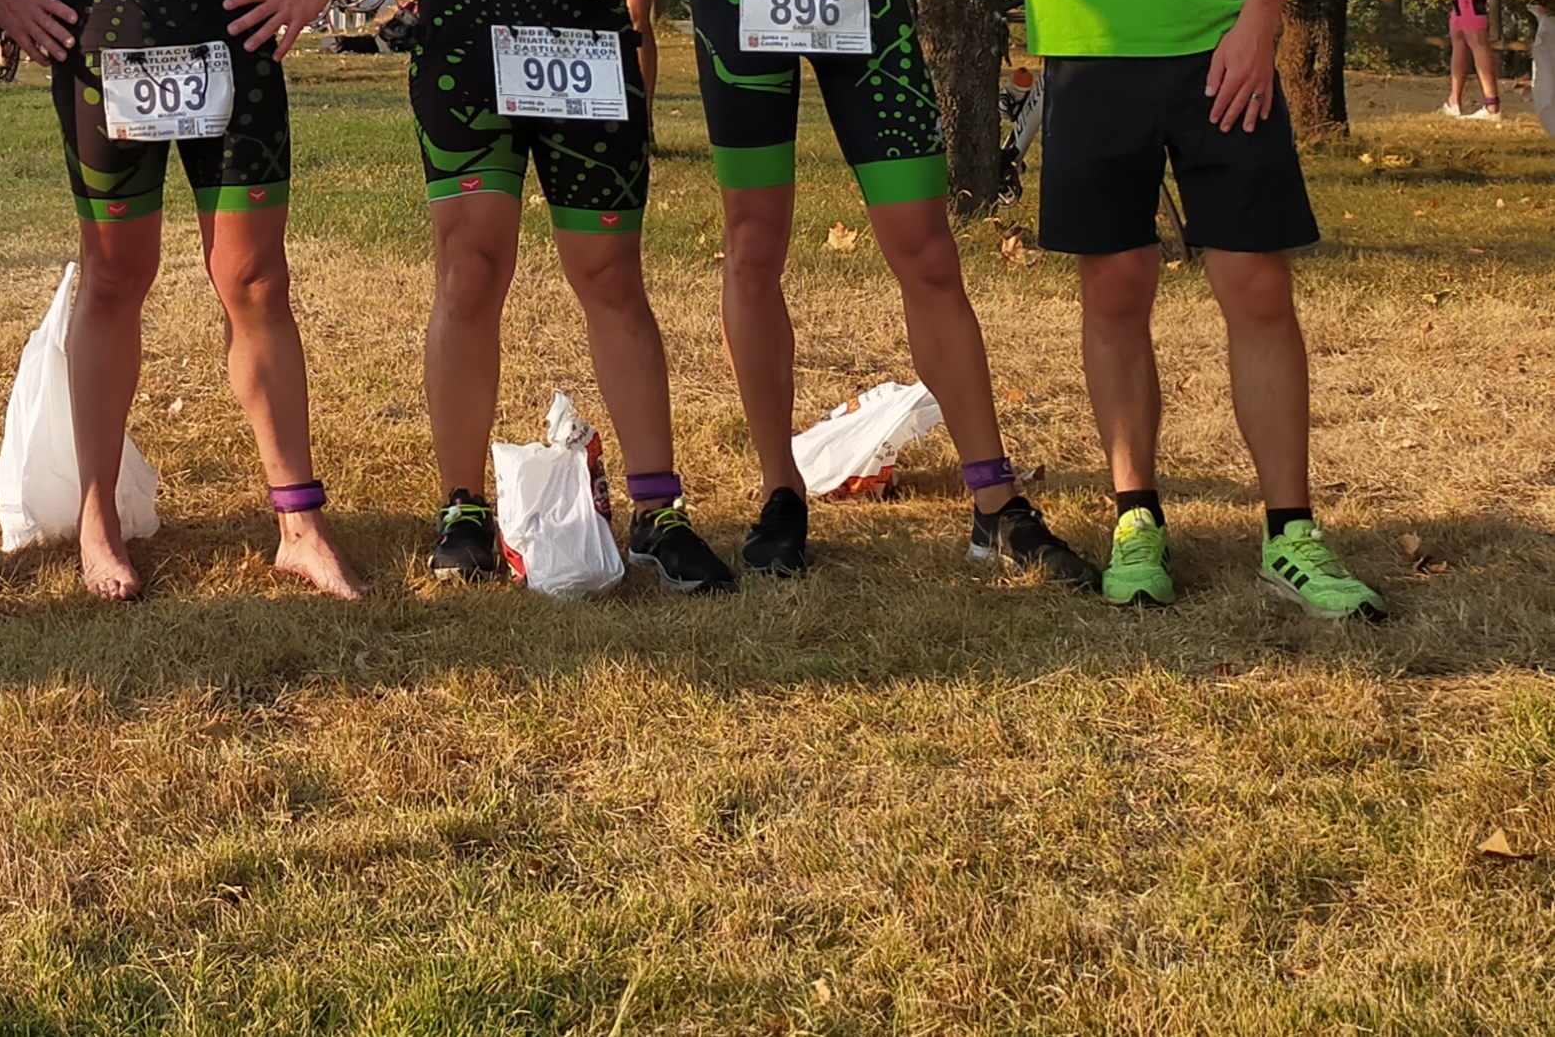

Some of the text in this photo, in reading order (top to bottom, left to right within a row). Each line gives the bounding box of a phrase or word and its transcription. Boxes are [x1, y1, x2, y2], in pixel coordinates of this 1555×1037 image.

[513, 44, 571, 54] CASTILLA
[585, 48, 617, 56] LEON
[523, 58, 592, 93] 909
[134, 75, 206, 115] 903
